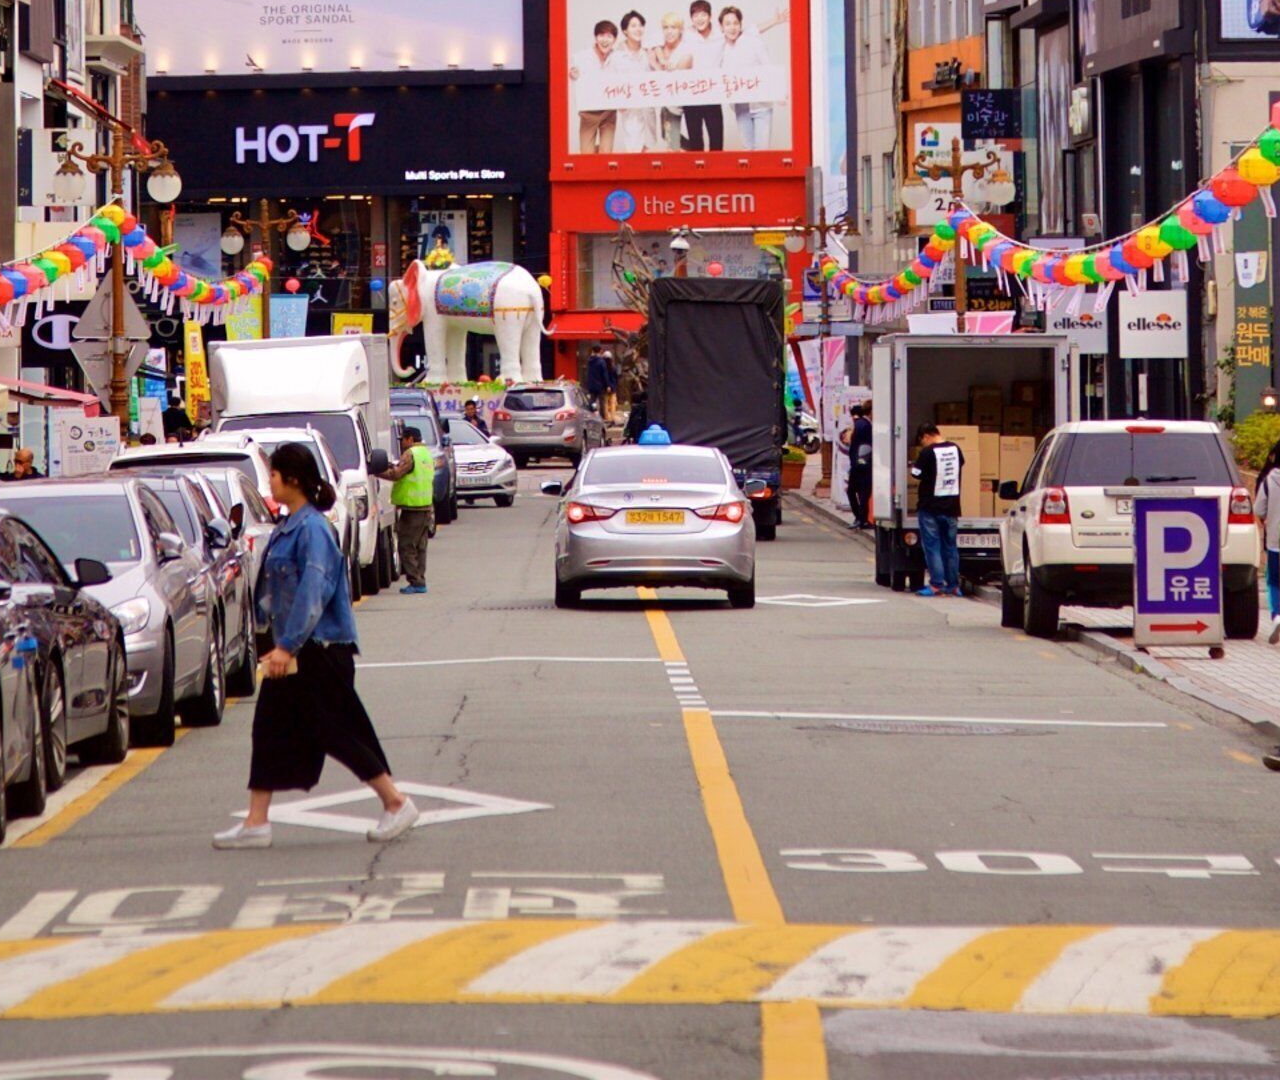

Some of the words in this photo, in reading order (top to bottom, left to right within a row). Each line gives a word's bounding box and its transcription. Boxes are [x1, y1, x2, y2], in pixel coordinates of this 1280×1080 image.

[263, 5, 288, 16] THE
[291, 3, 352, 15] ORIGINAL
[259, 16, 301, 26] SPORT
[306, 14, 355, 26] SANDAL
[235, 112, 375, 164] HOT-T
[405, 170, 426, 180] Multi
[428, 170, 458, 182] Sports
[459, 170, 479, 180] Plex
[480, 169, 505, 180] Store
[644, 195, 675, 214] the
[680, 194, 755, 214] SAEM
[1236, 306, 1248, 318] 갓
[1053, 316, 1103, 332] ellesse
[1126, 316, 1182, 333] ellesse
[1236, 322, 1269, 342] 원두
[1236, 345, 1270, 367] 판매
[1147, 510, 1210, 602] P
[1169, 576, 1213, 601] 유료
